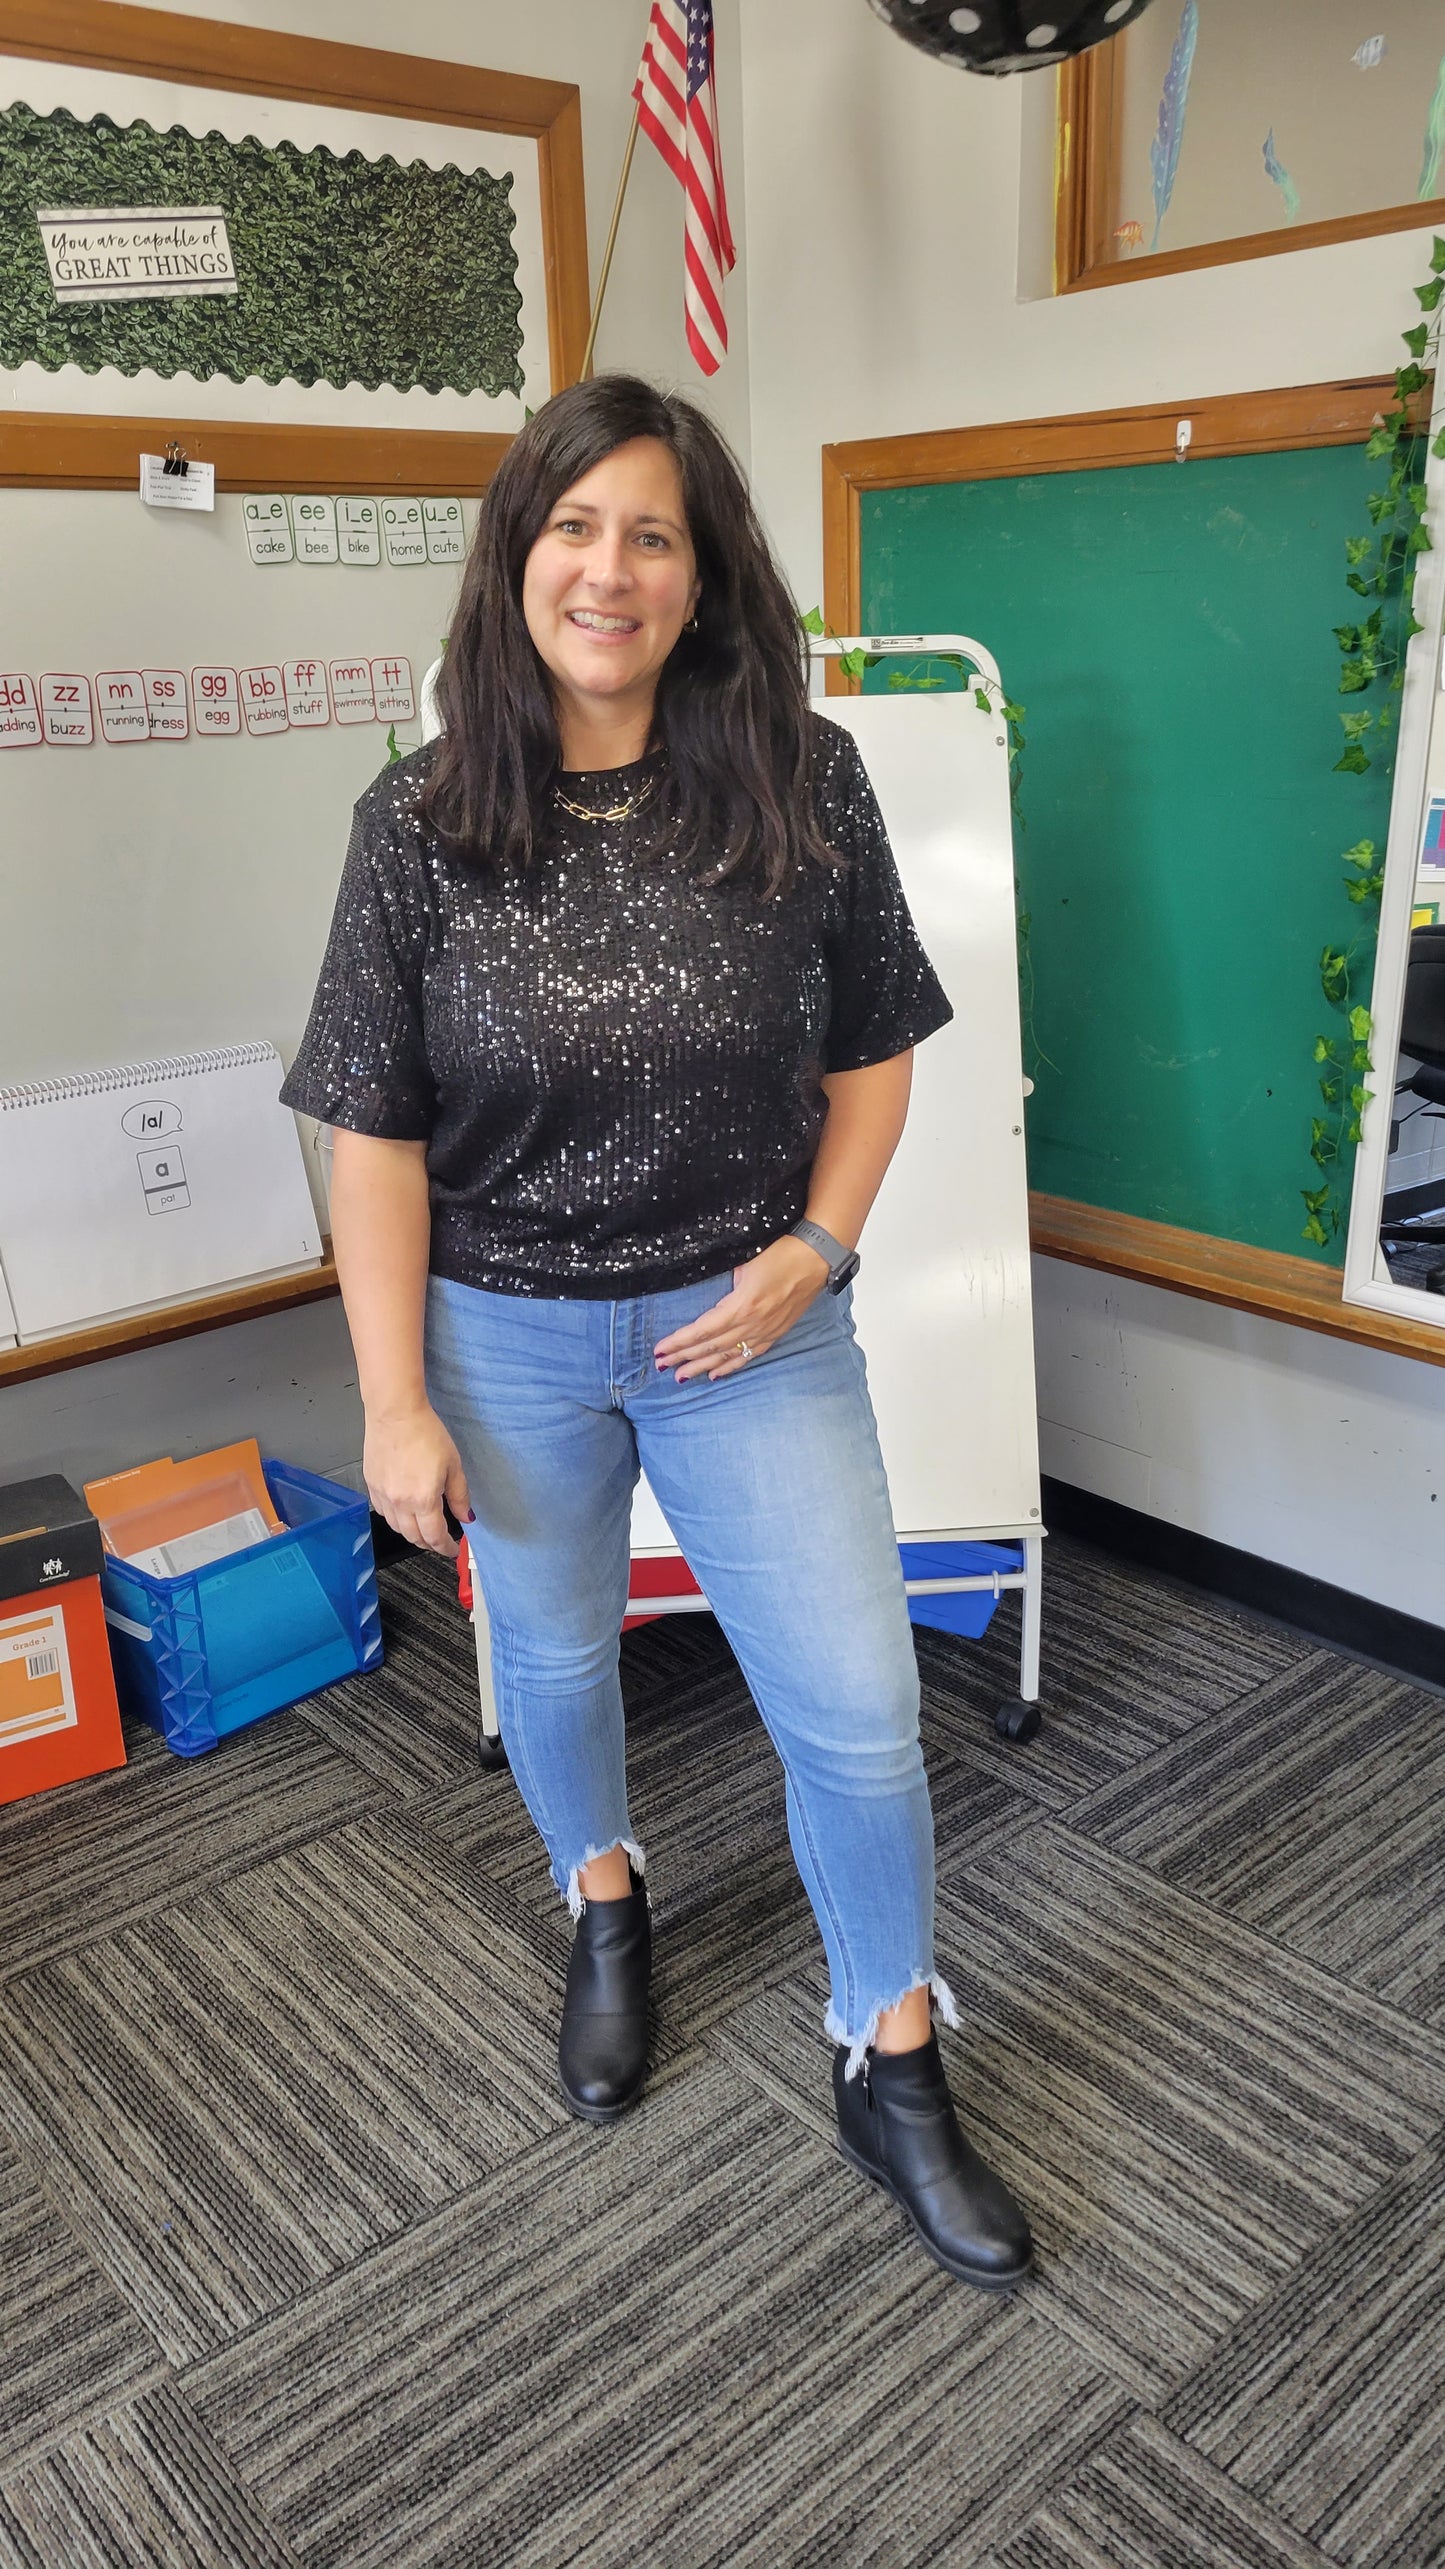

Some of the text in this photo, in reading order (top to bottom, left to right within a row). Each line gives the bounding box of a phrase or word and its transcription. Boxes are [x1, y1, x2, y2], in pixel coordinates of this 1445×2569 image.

[52, 225, 218, 259] You are capable of
[55, 252, 229, 281] GREAT THINGS
[300, 505, 325, 520] ee
[256, 537, 286, 554] cake
[305, 537, 329, 553] bee
[348, 537, 370, 553] bike
[390, 540, 423, 556] home
[433, 537, 459, 554] cute
[293, 663, 316, 687] ff
[335, 666, 366, 682] mm
[382, 662, 401, 686] tt
[0, 679, 26, 706] dd
[108, 683, 133, 699] nn
[152, 681, 175, 697] ss
[201, 675, 227, 697] gg
[249, 672, 276, 698] bb
[53, 686, 80, 702] zz
[293, 700, 323, 715] stuff
[335, 697, 375, 710] swimming
[379, 697, 411, 710] sitting
[106, 715, 144, 727] running
[205, 710, 230, 725] egg
[248, 708, 287, 722] rubbing
[50, 718, 86, 736] buzz
[155, 1162, 169, 1177] a
[160, 1194, 176, 1206] pat
[12, 1636, 47, 1651] Grade 1
